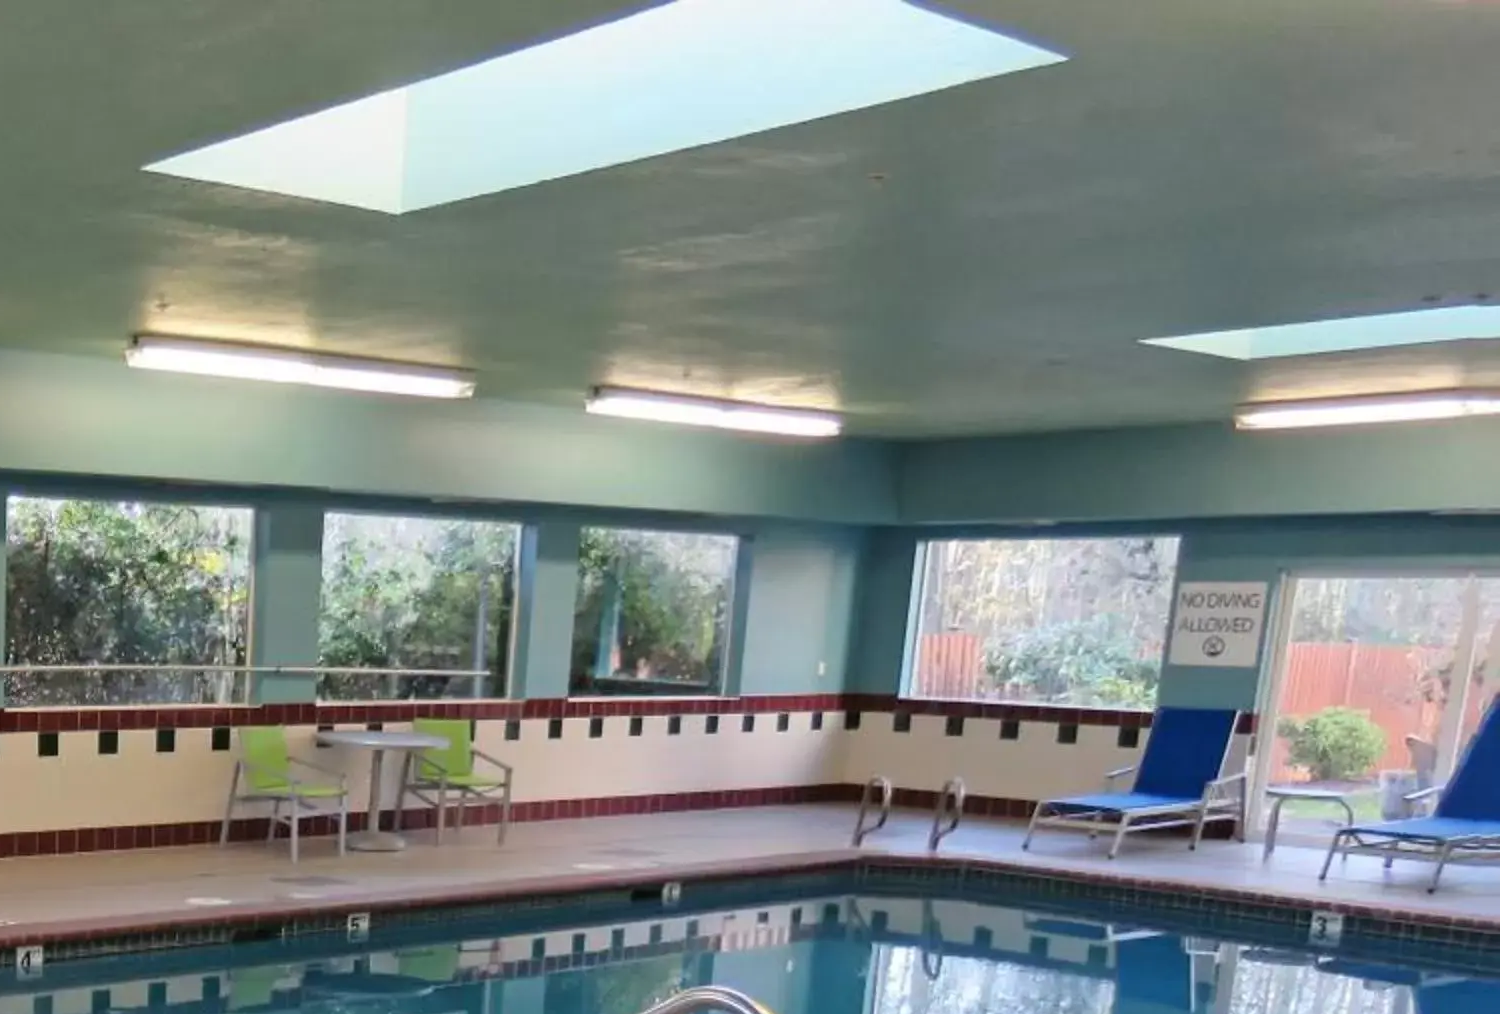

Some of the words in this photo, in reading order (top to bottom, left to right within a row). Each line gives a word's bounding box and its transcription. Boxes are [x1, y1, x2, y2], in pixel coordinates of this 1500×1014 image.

[1180, 592, 1205, 609] NO
[1206, 592, 1261, 609] DIVING
[1179, 616, 1255, 634] ALLOWED
